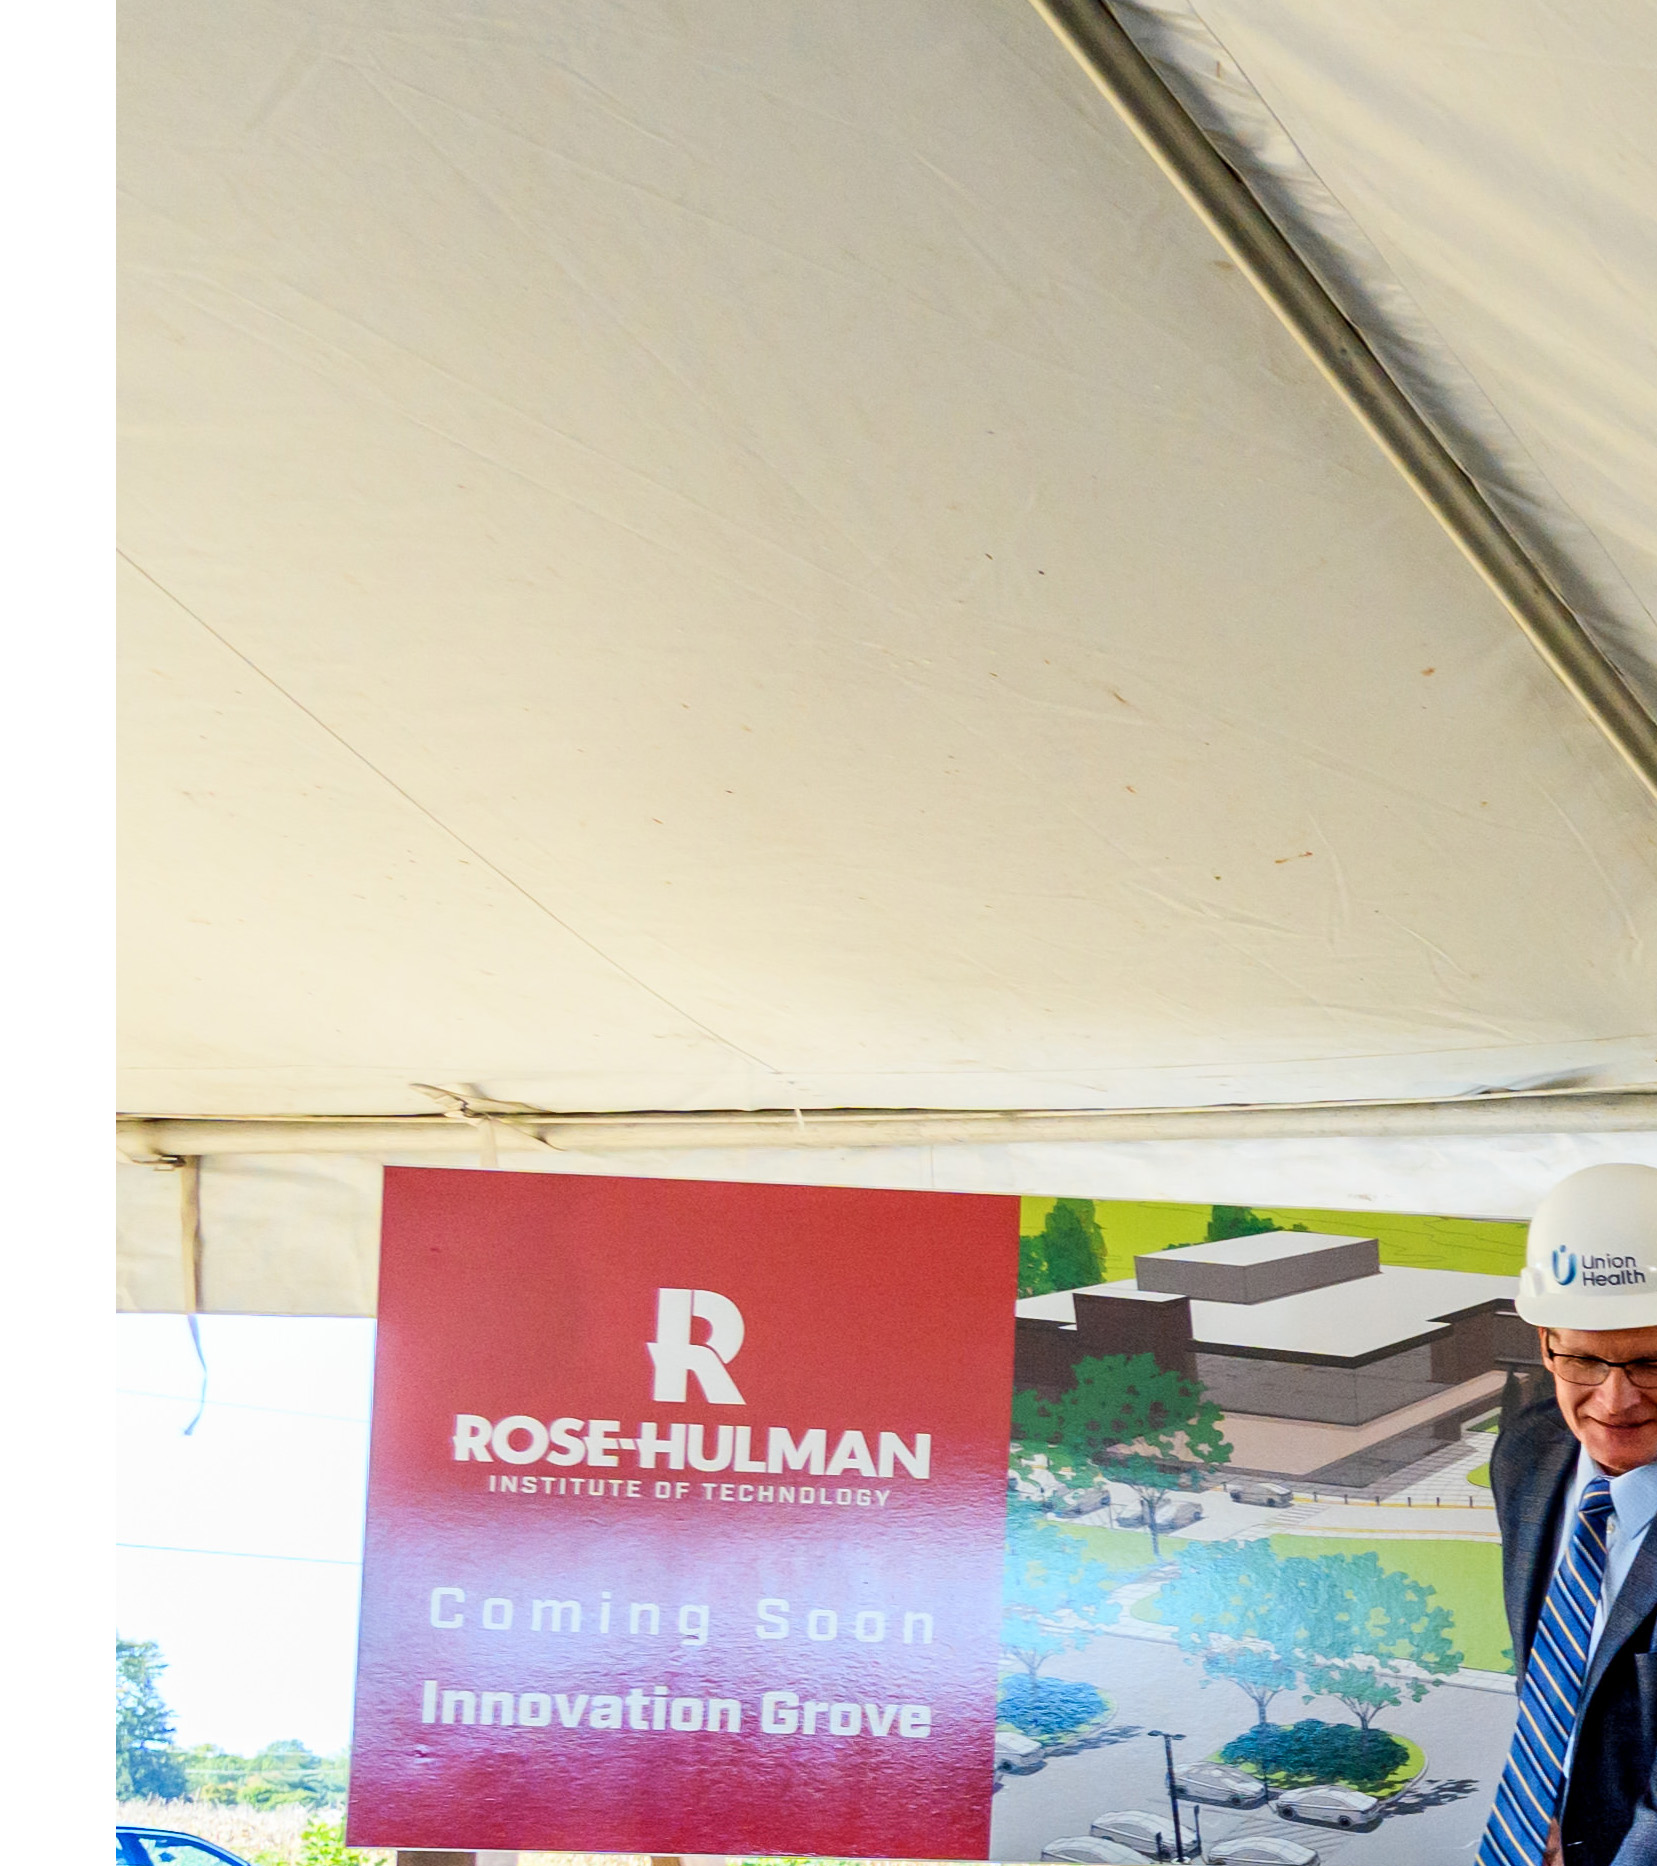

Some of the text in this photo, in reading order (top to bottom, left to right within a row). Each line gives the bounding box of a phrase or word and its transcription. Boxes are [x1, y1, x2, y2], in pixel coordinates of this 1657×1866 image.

[1582, 1253, 1637, 1269] Union
[1582, 1270, 1646, 1286] Health
[647, 1287, 746, 1405] R
[452, 1414, 931, 1479] ROSE-HULMAN
[489, 1475, 891, 1507] INSTITUTE OF TECHNOLOGY
[430, 1586, 933, 1645] Coming Soon
[421, 1680, 932, 1738] Innovation Grove
